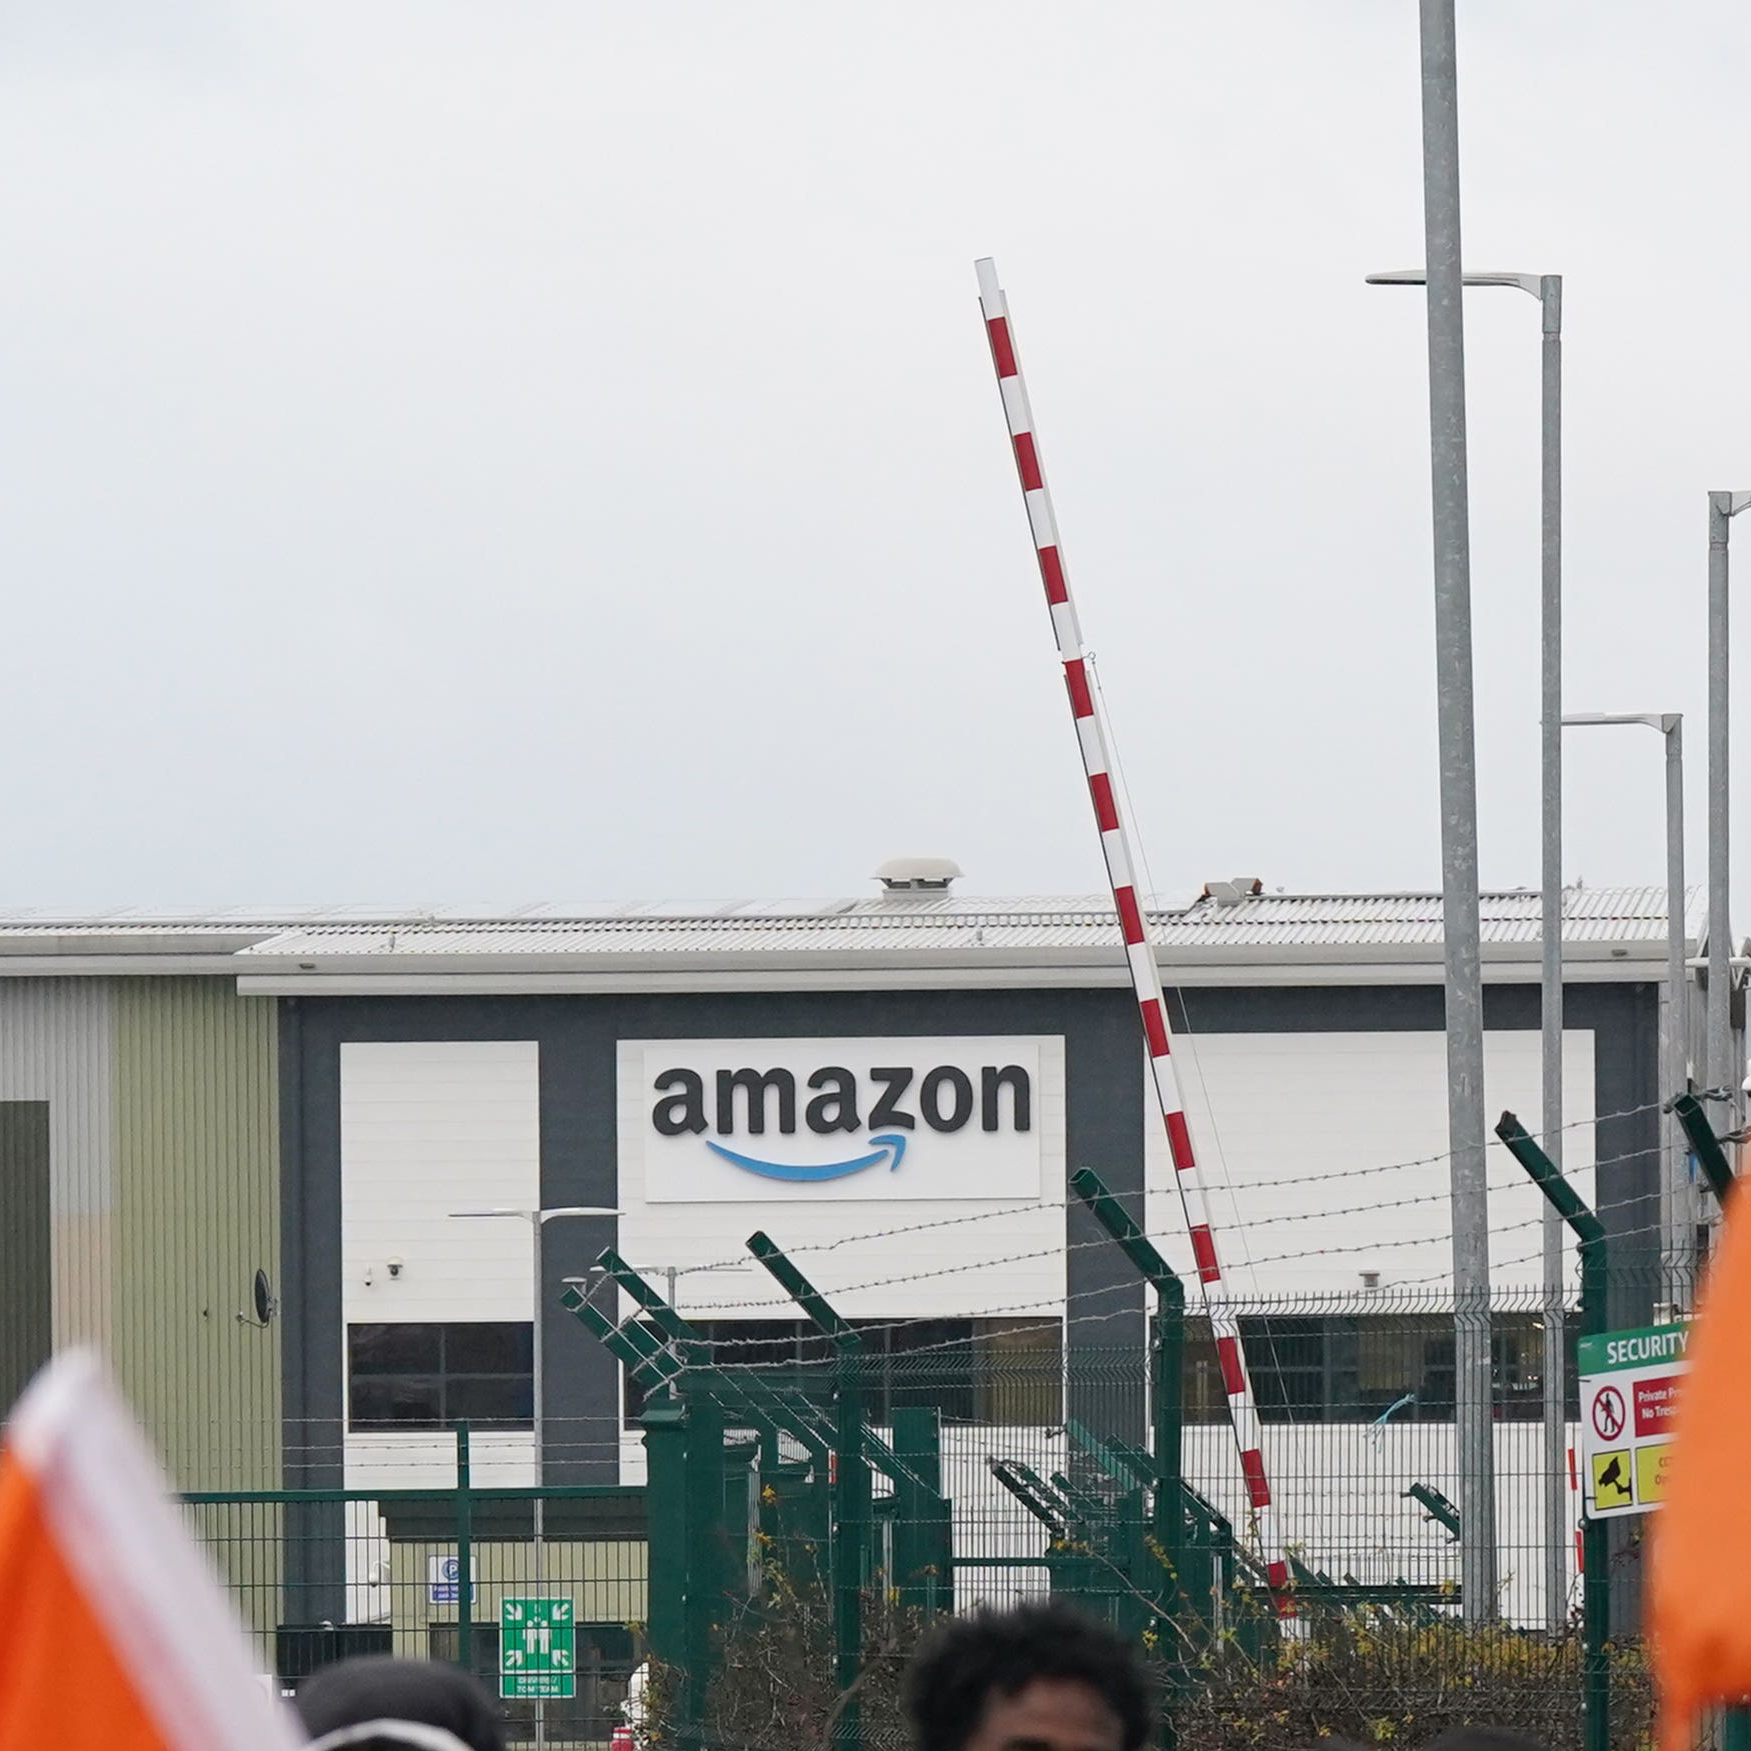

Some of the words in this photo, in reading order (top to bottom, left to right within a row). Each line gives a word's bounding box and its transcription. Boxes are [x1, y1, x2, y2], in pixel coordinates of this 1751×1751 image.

[651, 1064, 1031, 1136] amazon
[1607, 1331, 1689, 1365] SECURITY
[1638, 1390, 1667, 1403] Private
[1642, 1408, 1654, 1419] No
